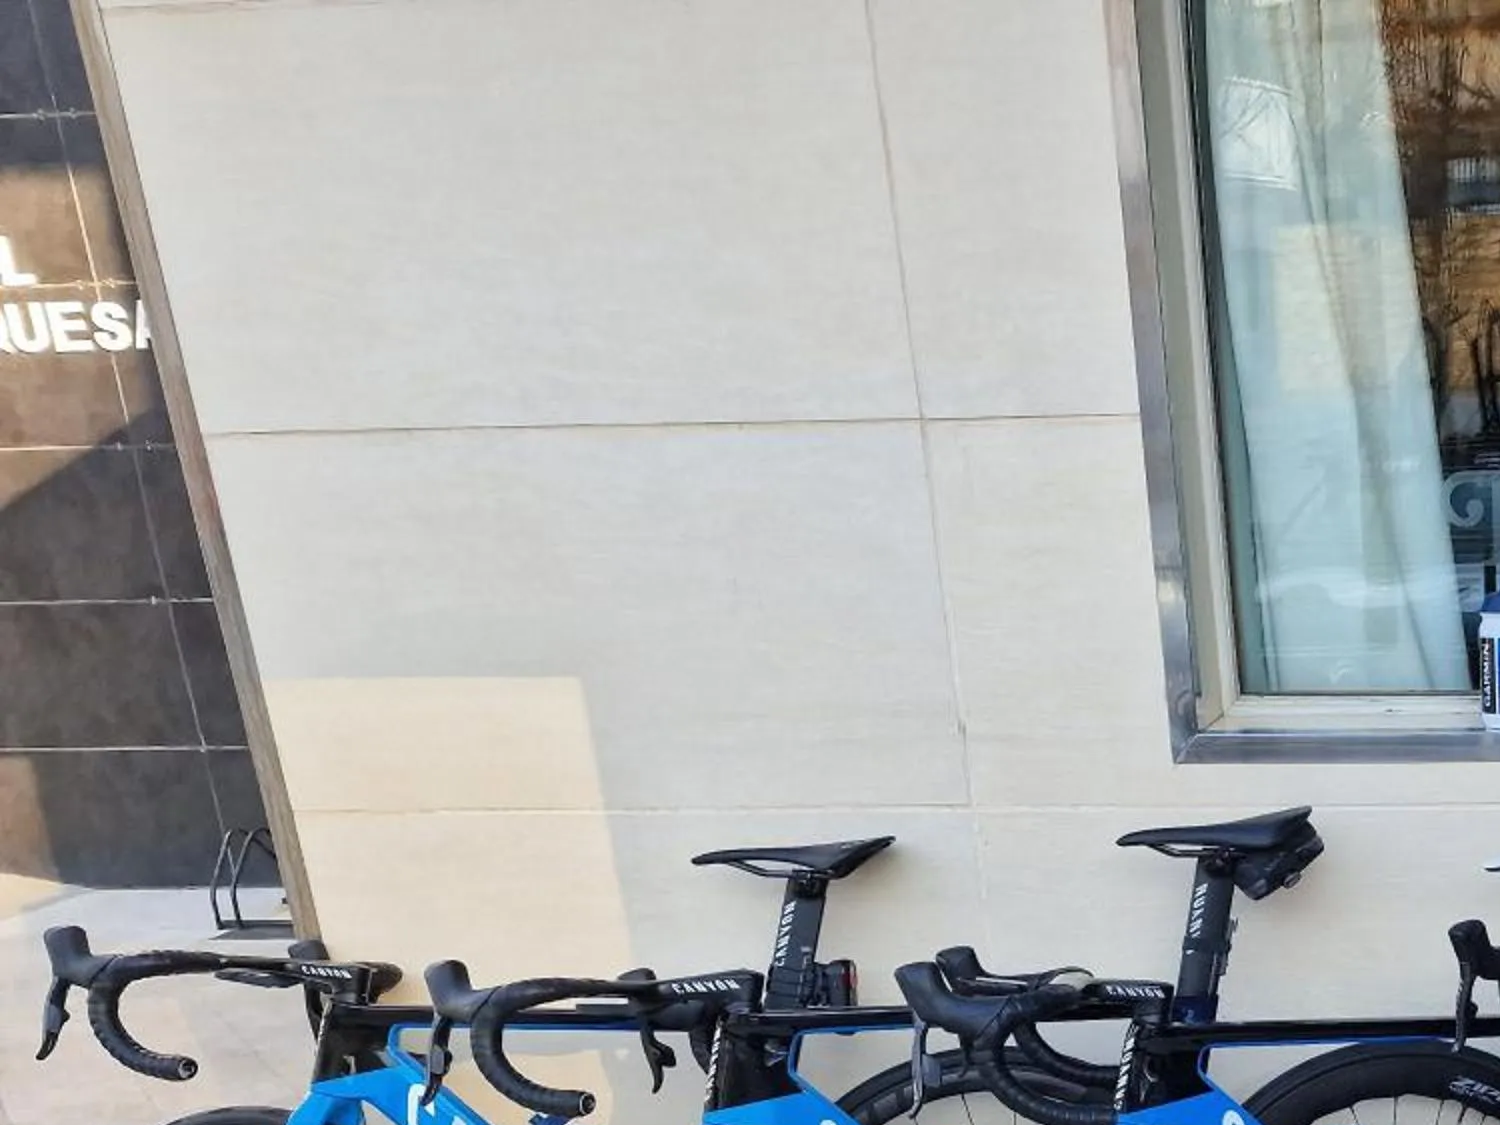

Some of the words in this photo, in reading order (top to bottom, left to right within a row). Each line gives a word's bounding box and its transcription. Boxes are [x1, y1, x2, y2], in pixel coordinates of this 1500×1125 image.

[1482, 642, 1492, 707] GARMIN
[775, 900, 797, 967] CANYON
[301, 964, 352, 980] CANYON
[672, 978, 741, 996] CANYON
[1106, 984, 1165, 1000] CANYON
